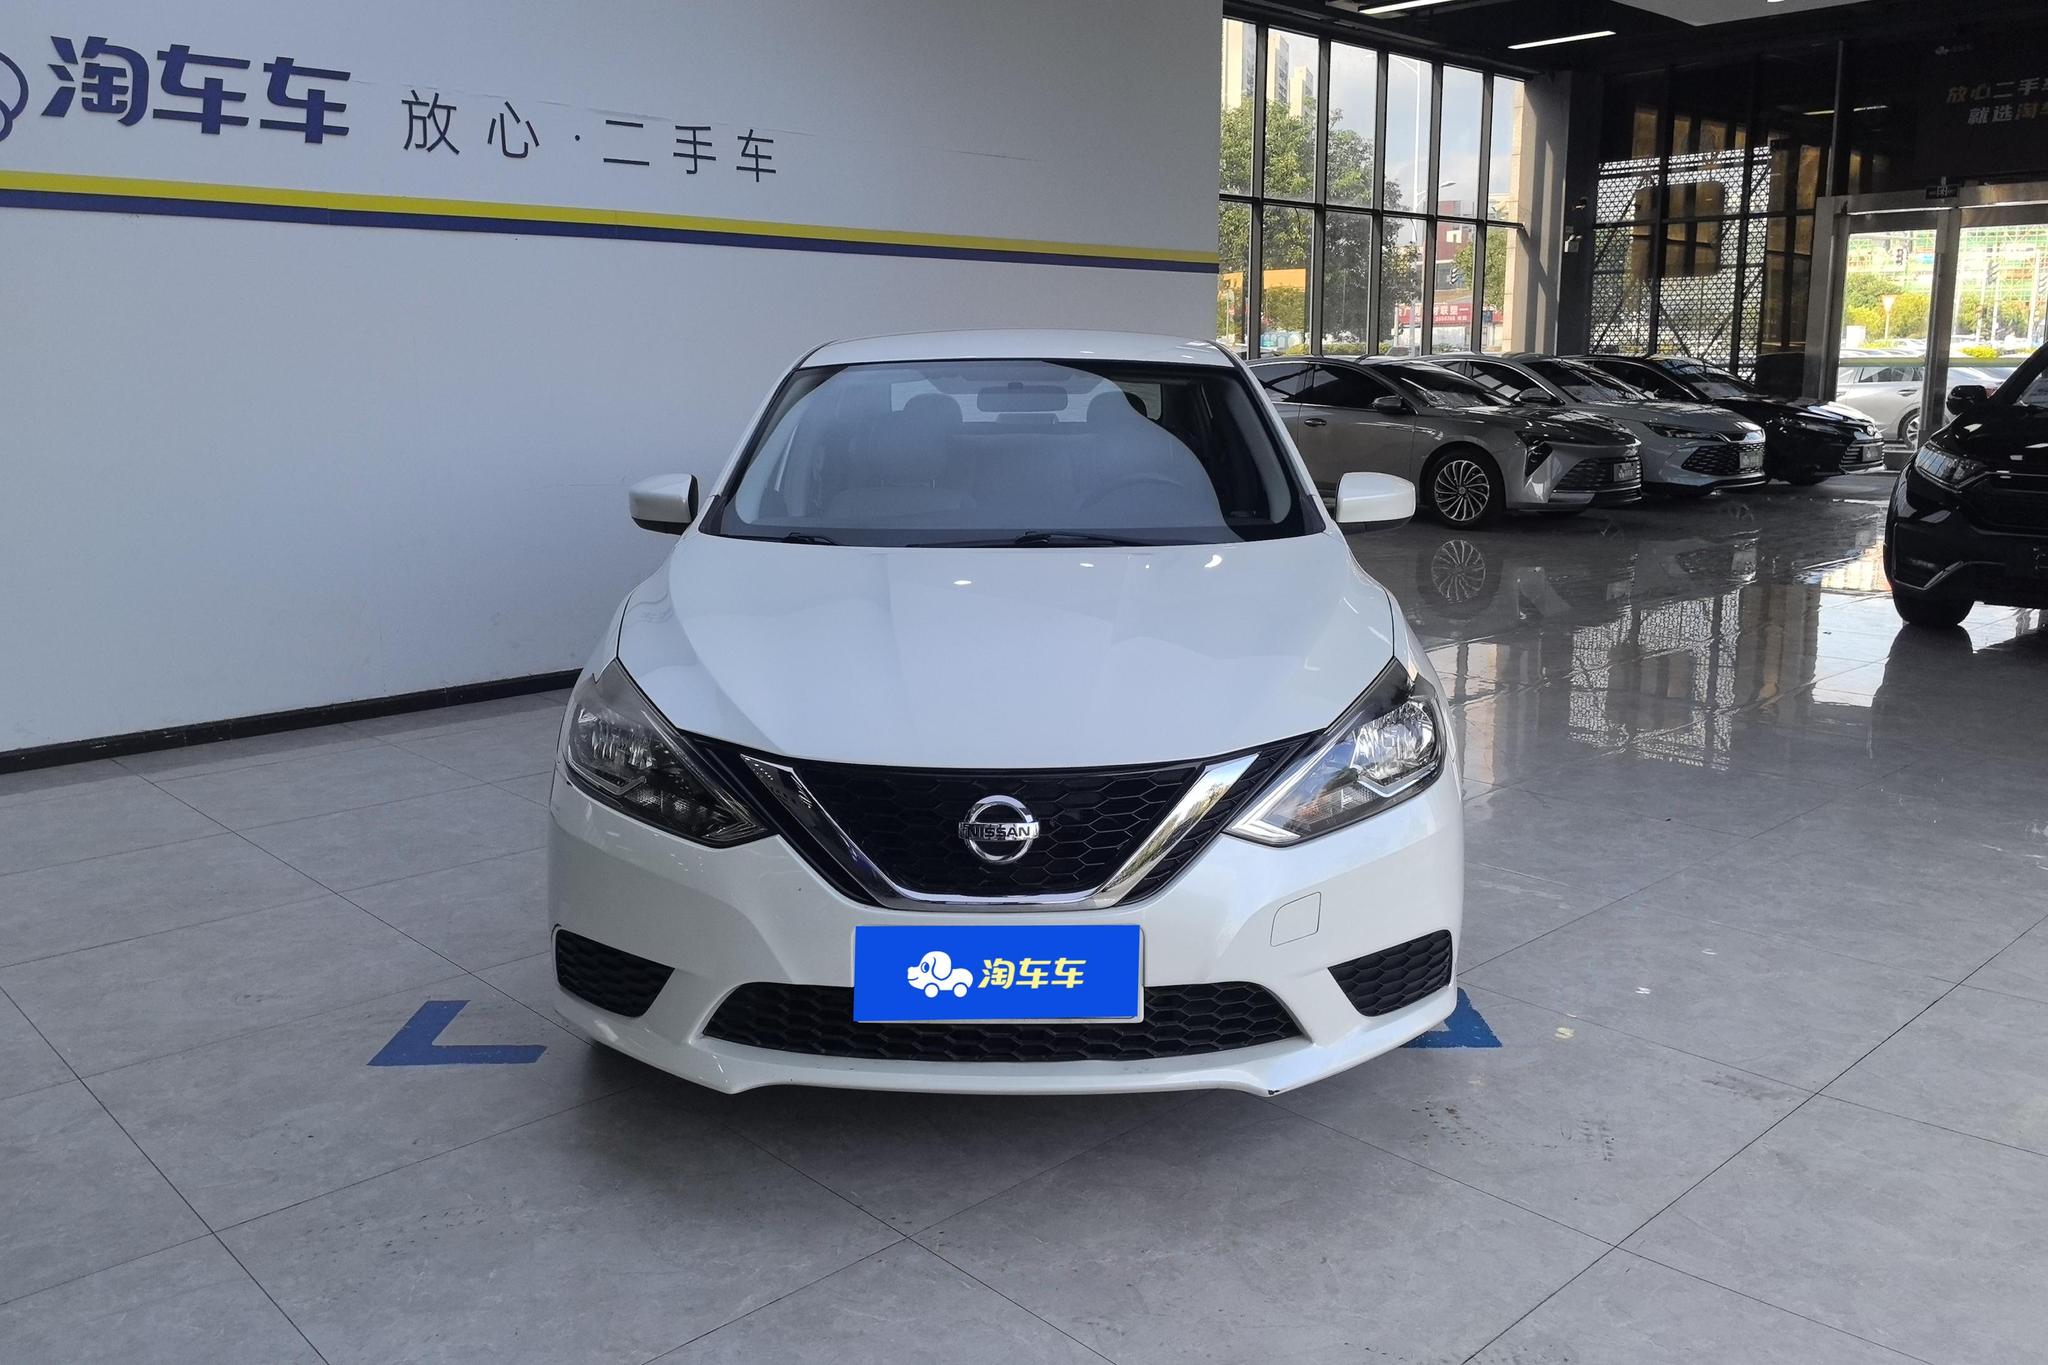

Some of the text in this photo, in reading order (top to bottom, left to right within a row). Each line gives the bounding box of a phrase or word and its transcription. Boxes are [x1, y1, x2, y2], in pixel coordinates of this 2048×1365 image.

[41, 36, 350, 144] 淘车车
[967, 825, 1031, 839] NISSAN
